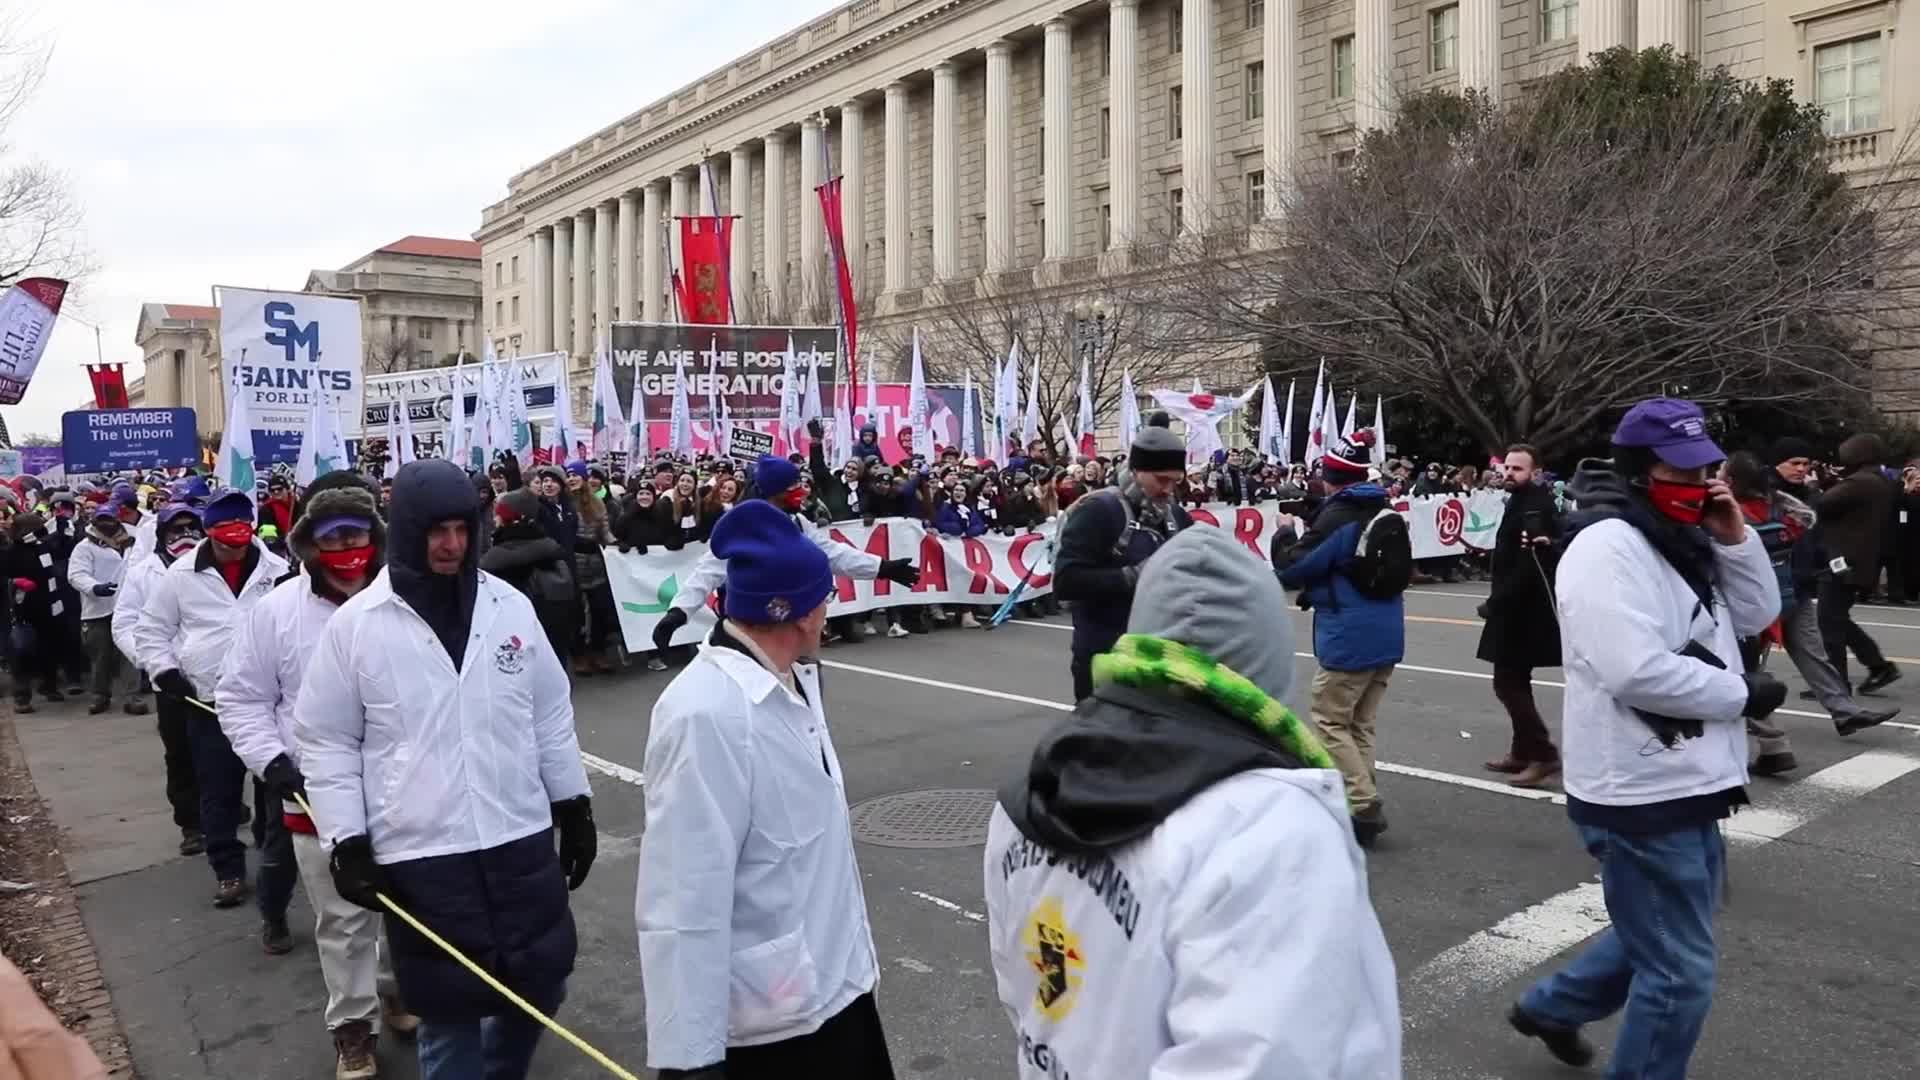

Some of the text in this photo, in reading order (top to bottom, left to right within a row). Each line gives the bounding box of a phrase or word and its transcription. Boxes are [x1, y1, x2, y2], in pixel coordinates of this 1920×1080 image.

[264, 301, 319, 362] SM
[0, 331, 24, 374] LIFE
[614, 350, 648, 366] WE
[653, 350, 694, 366] ARE
[700, 351, 738, 367] THE
[642, 373, 806, 396] GENERATION
[255, 391, 330, 407] FOR LI
[88, 411, 172, 427] REMEMBER
[91, 428, 174, 441] The Unborn
[830, 522, 1053, 604] MARC
